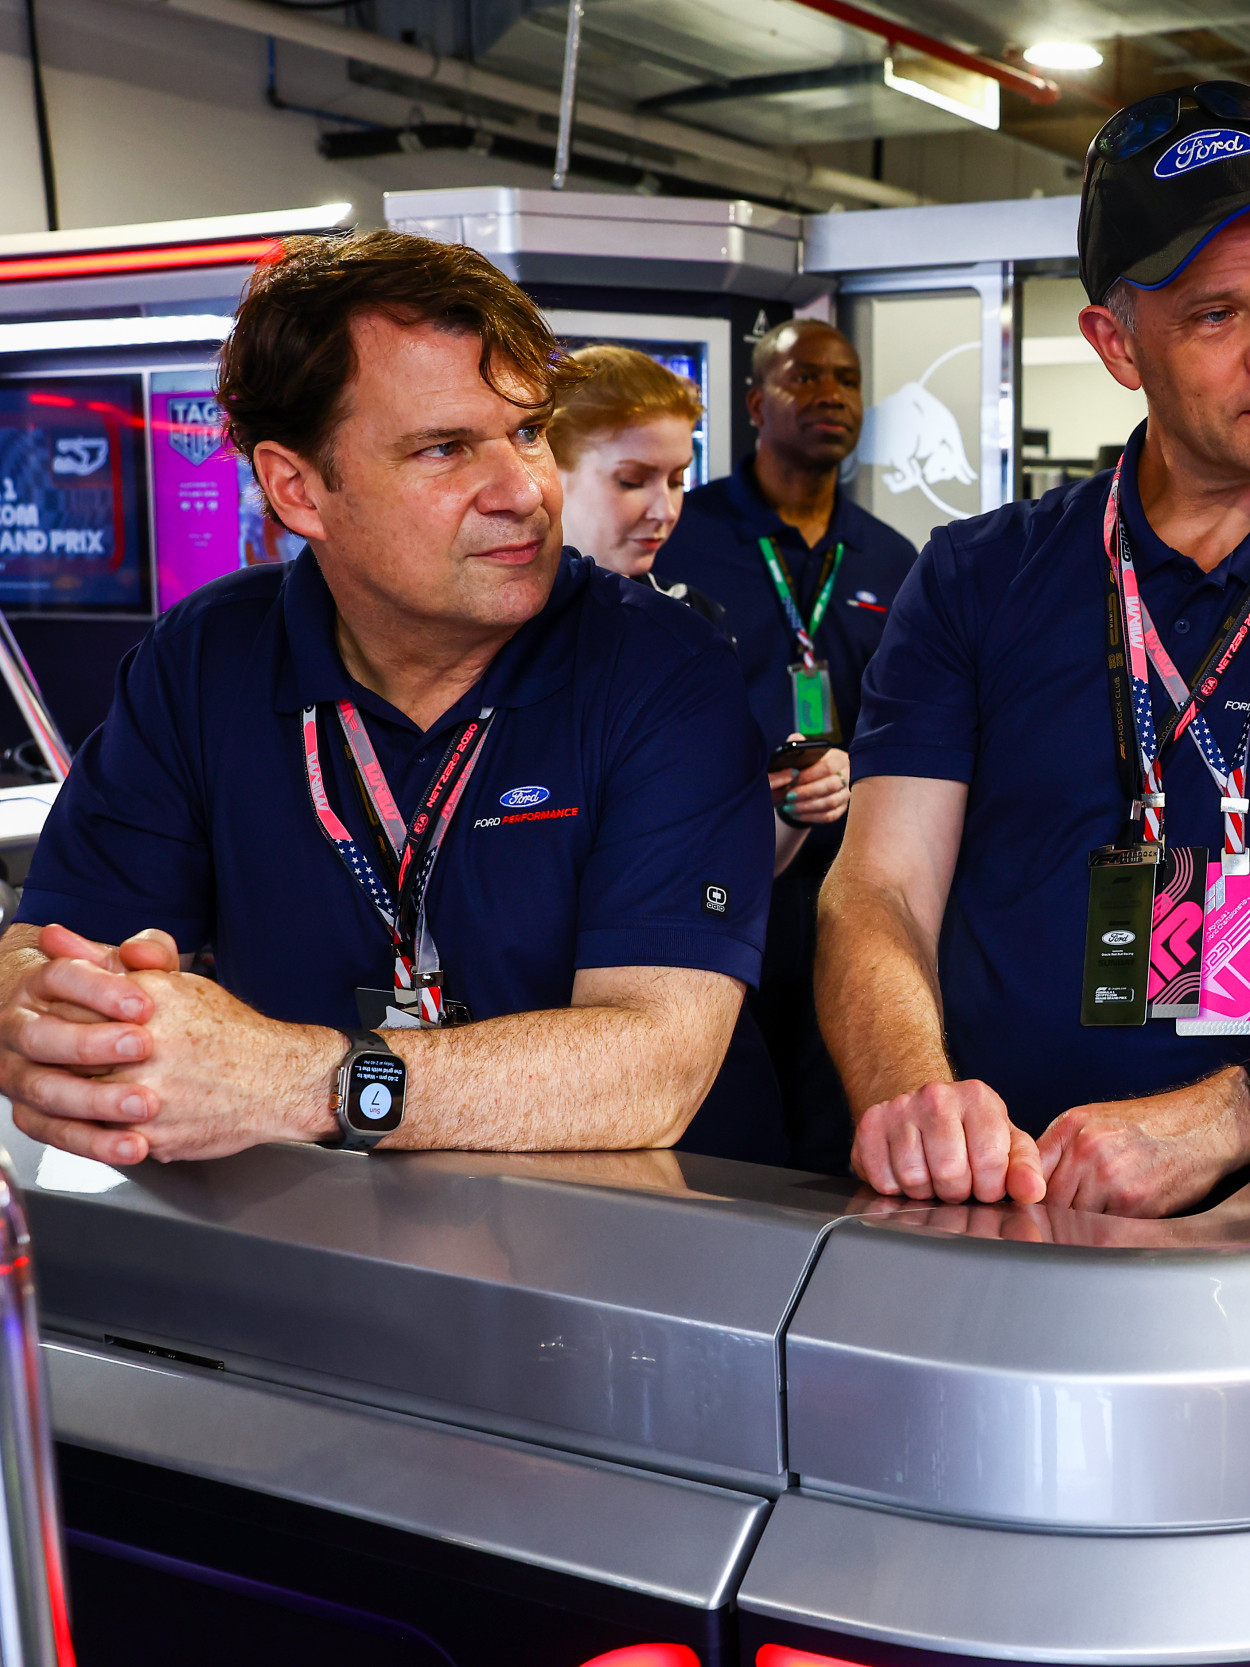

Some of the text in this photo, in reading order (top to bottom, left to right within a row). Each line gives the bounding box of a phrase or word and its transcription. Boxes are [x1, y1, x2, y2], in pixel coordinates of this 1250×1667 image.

[1175, 132, 1244, 169] Ford
[50, 529, 104, 553] PRIX
[1126, 596, 1144, 649] MIAMI
[457, 723, 479, 752] 2030
[509, 789, 539, 804] Ford
[474, 807, 579, 829] FORD PERFORMANCE
[1108, 933, 1129, 942] Ford
[371, 1091, 380, 1105] 7
